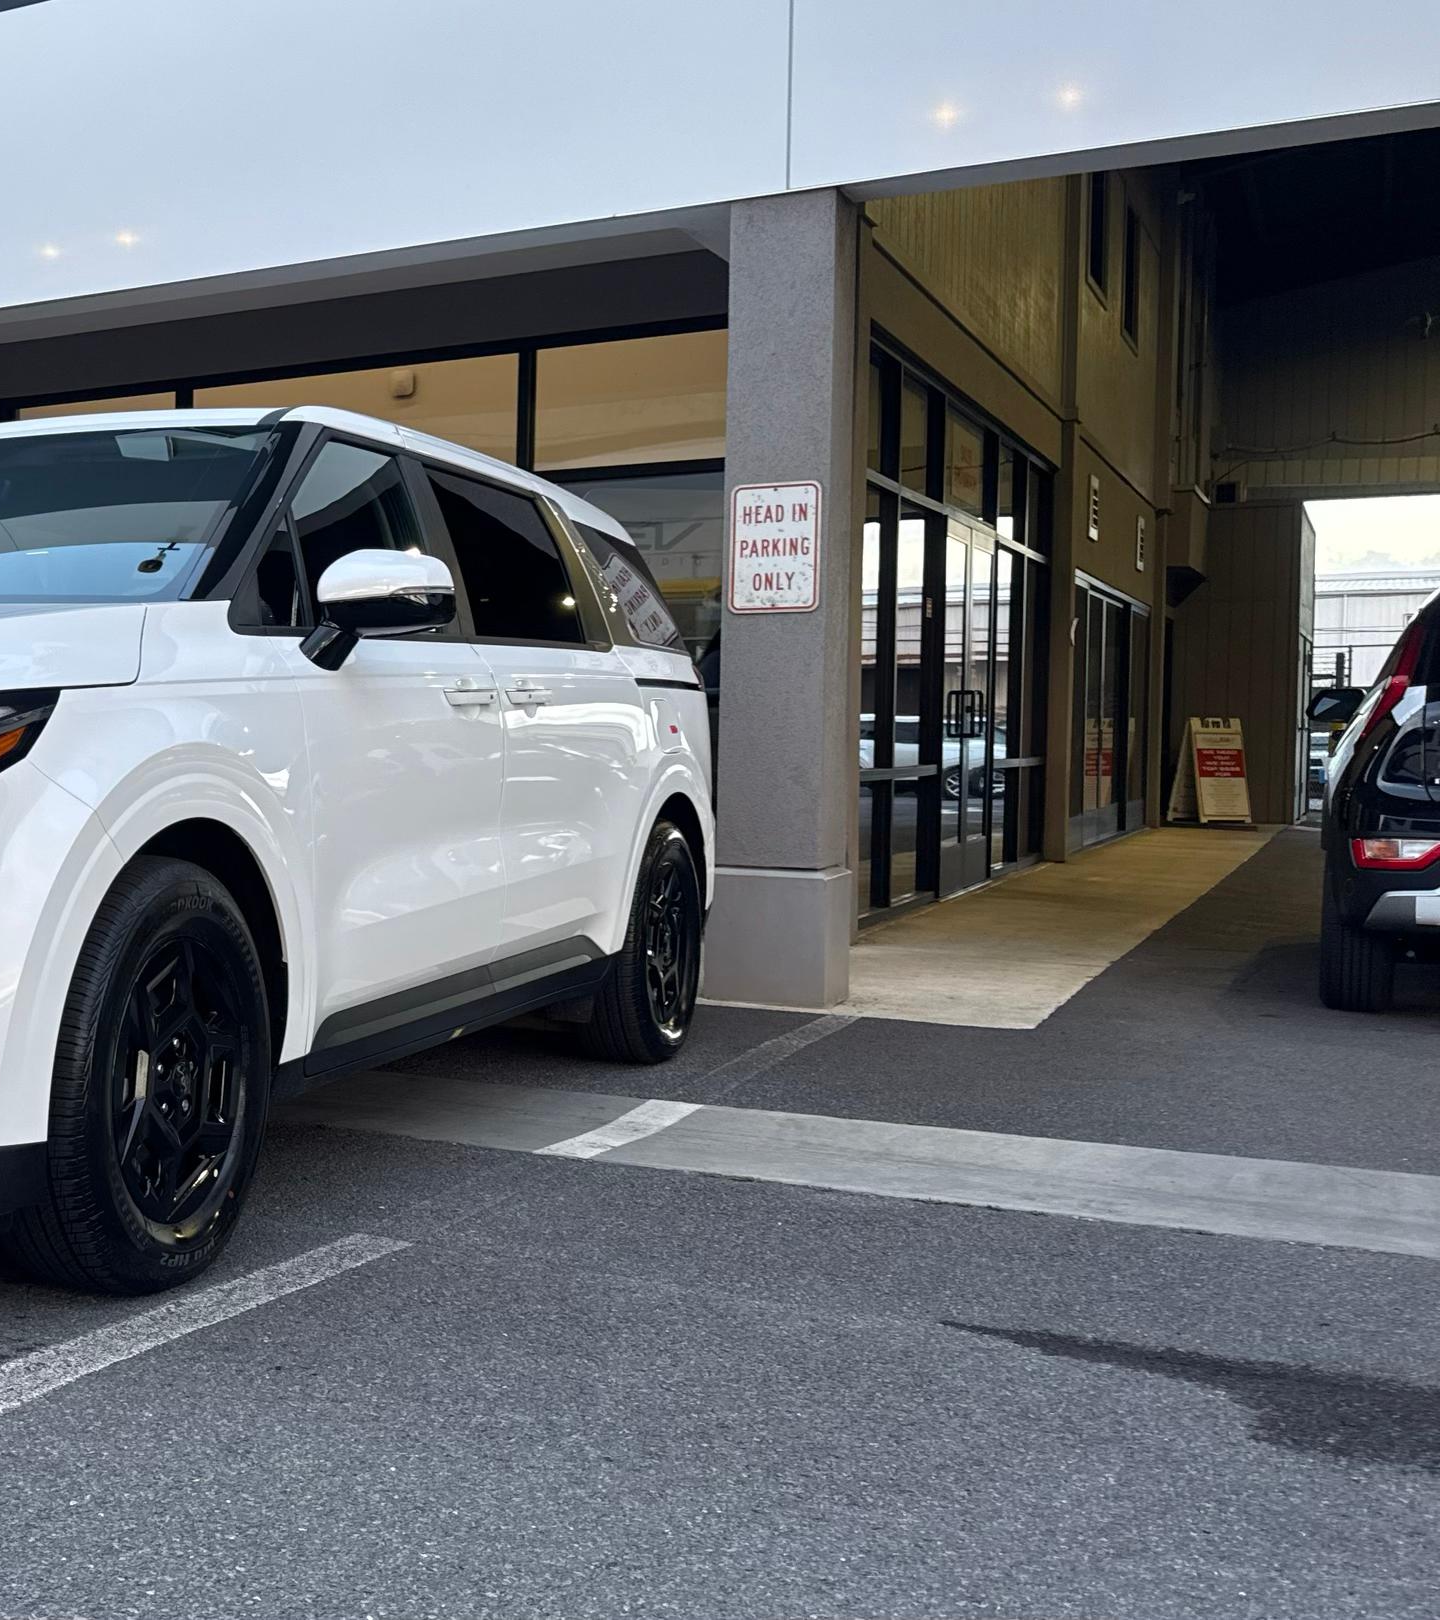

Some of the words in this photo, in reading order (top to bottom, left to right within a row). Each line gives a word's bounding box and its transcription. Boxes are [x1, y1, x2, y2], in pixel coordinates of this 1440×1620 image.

[743, 505, 784, 524] HEAD
[792, 503, 808, 522] IN
[740, 537, 810, 558] PARKING
[753, 572, 795, 591] ONLY
